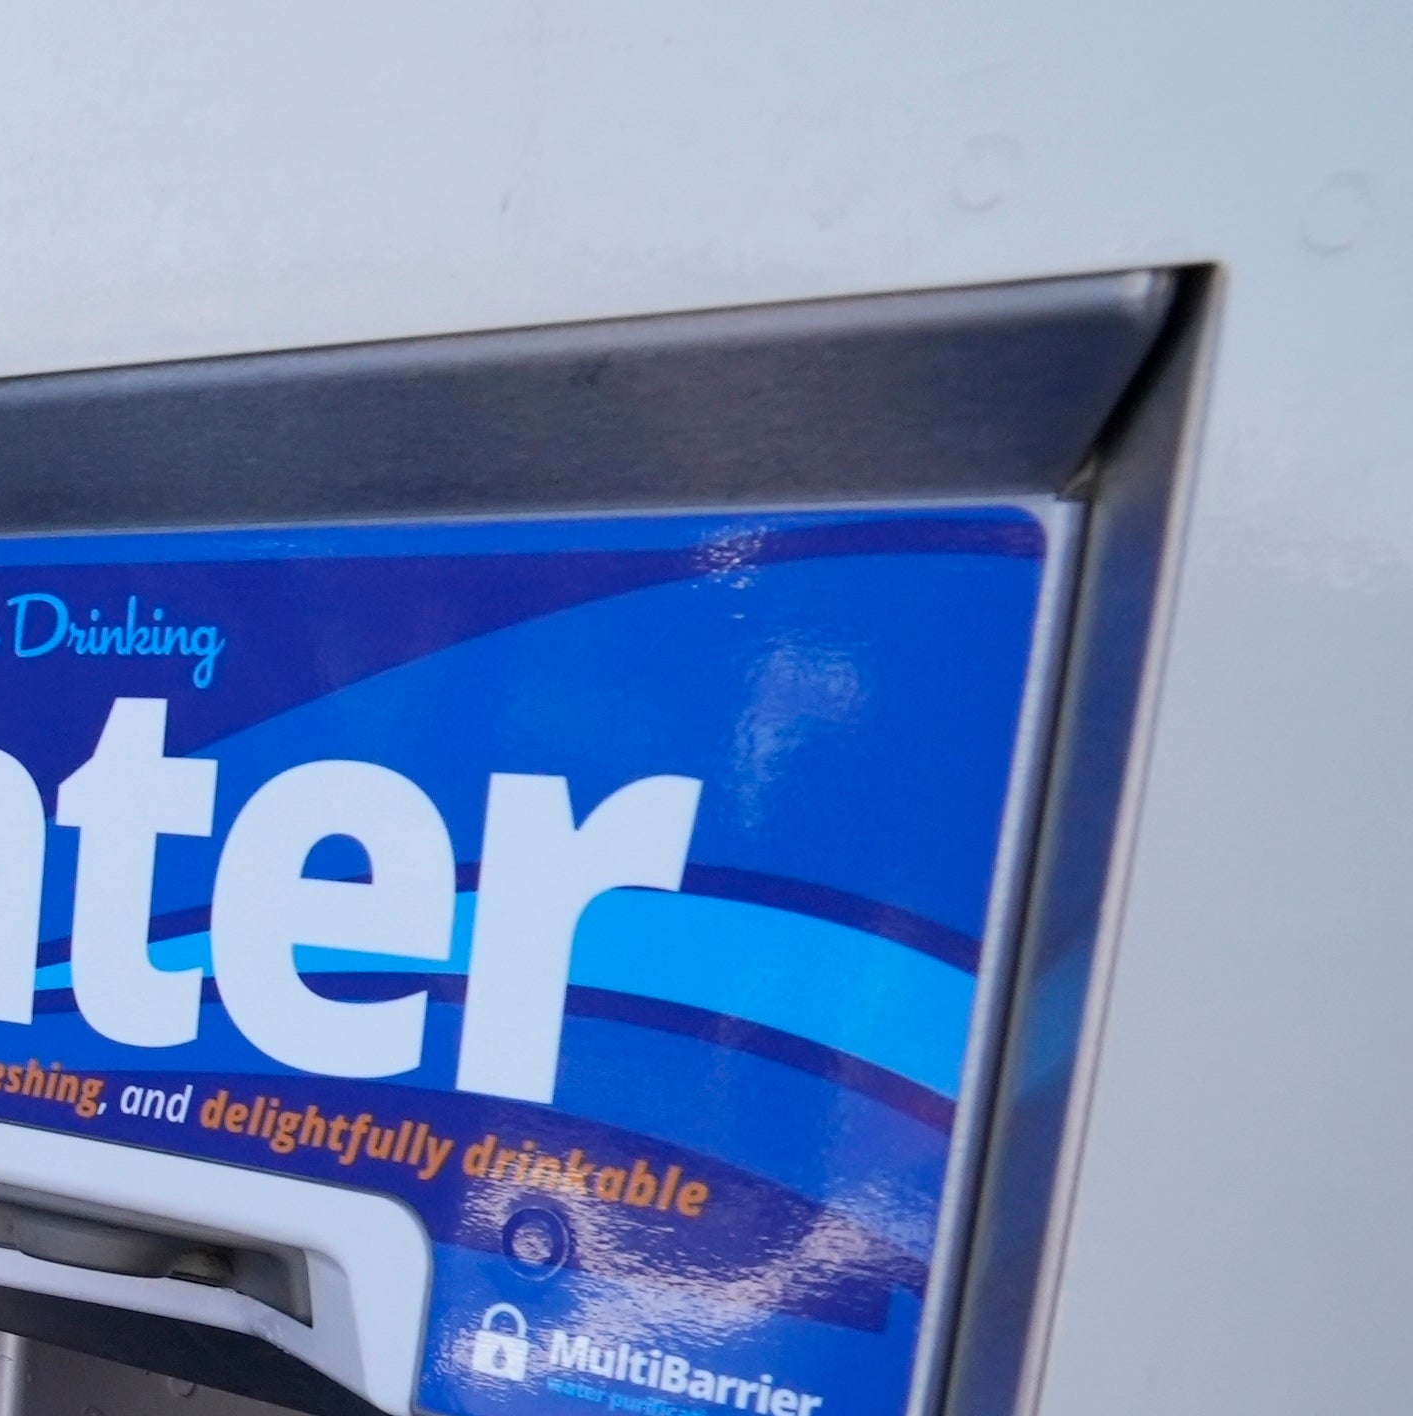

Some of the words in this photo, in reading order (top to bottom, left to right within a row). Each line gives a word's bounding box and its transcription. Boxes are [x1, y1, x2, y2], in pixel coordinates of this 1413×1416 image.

[7, 592, 225, 689] Drinking
[120, 1085, 193, 1123] and
[200, 1090, 453, 1180] delightfully
[463, 1134, 709, 1218] drinkable
